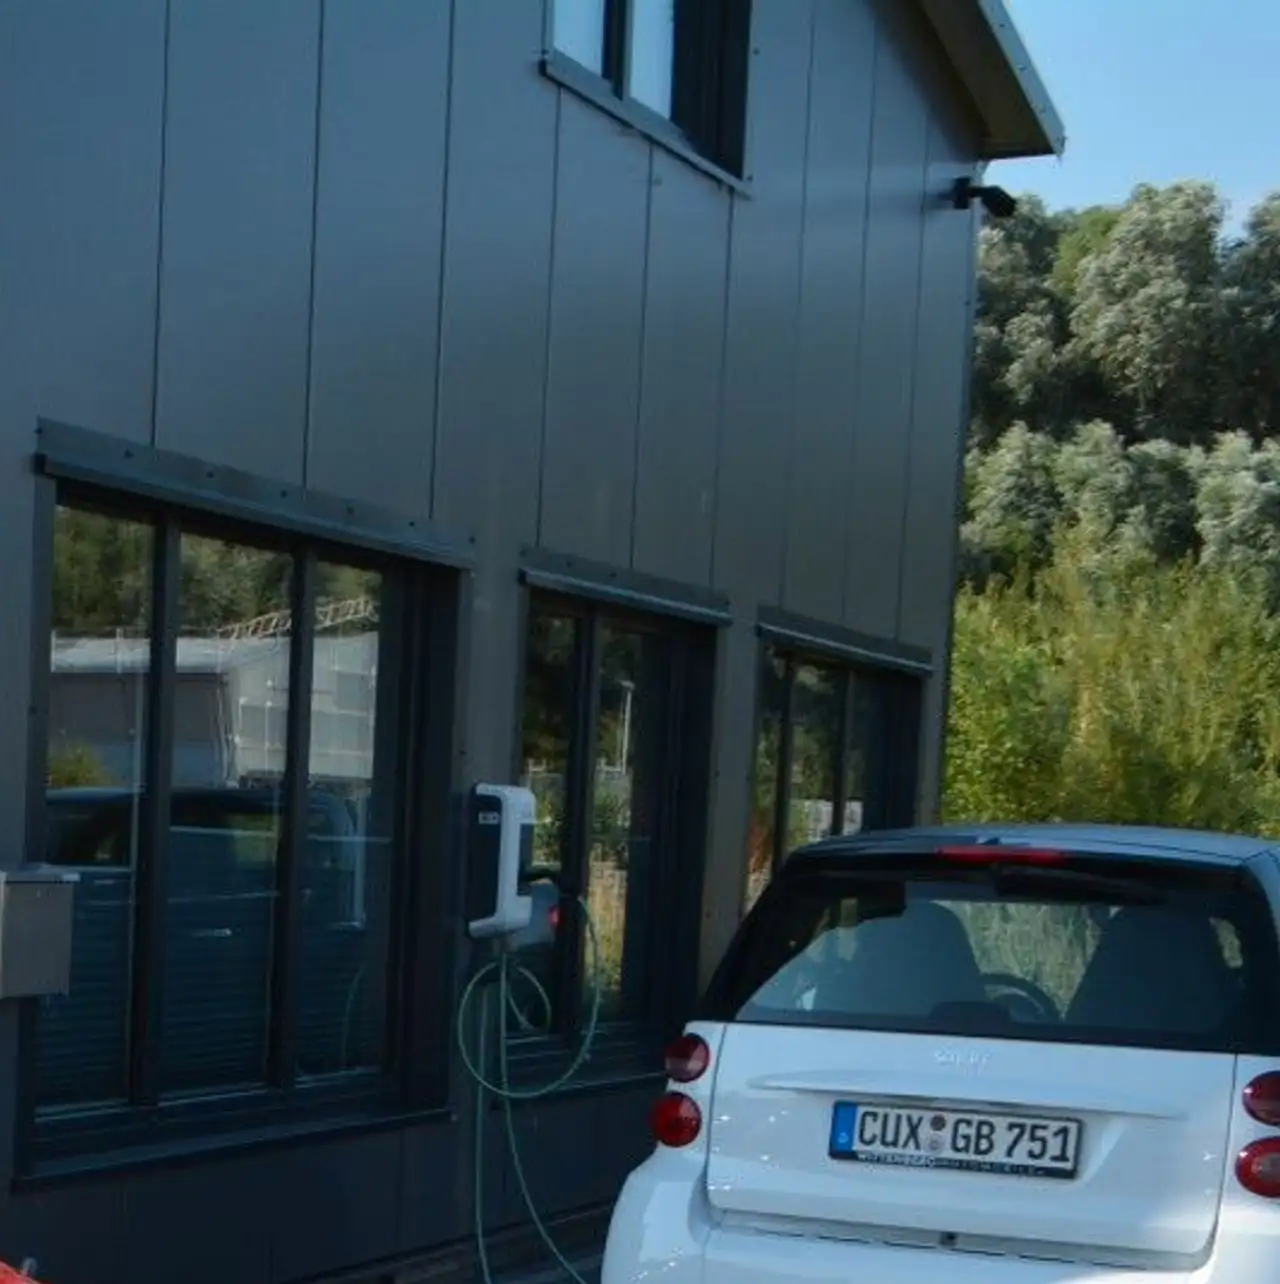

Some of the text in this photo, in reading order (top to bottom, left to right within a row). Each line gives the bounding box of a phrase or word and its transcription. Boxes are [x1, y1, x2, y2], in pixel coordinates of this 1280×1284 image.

[858, 1110, 1071, 1162] CUX GB 751
